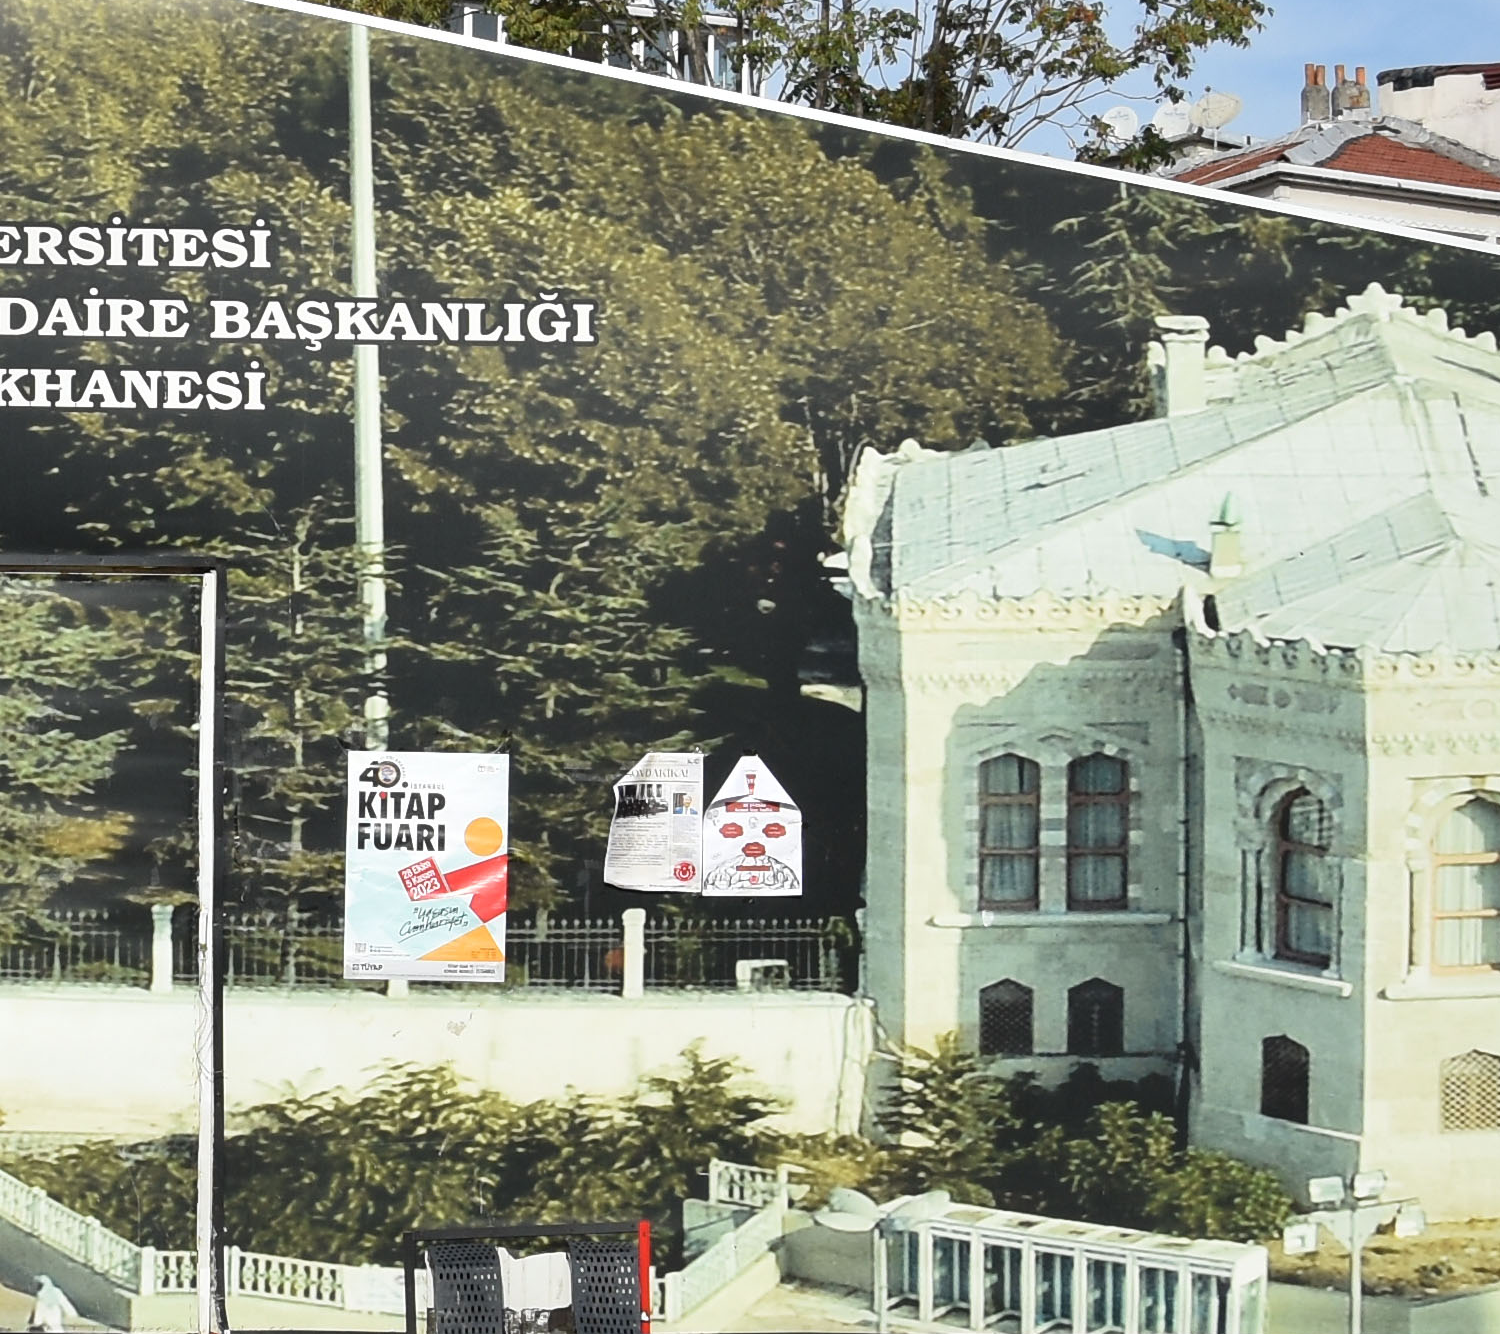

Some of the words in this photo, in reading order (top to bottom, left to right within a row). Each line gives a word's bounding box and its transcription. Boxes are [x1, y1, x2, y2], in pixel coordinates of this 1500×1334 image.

[208, 291, 598, 353] BAŞKANLIĞI
[358, 791, 446, 820] KİTAP
[357, 823, 446, 851] FUARI
[410, 877, 441, 900] 2023
